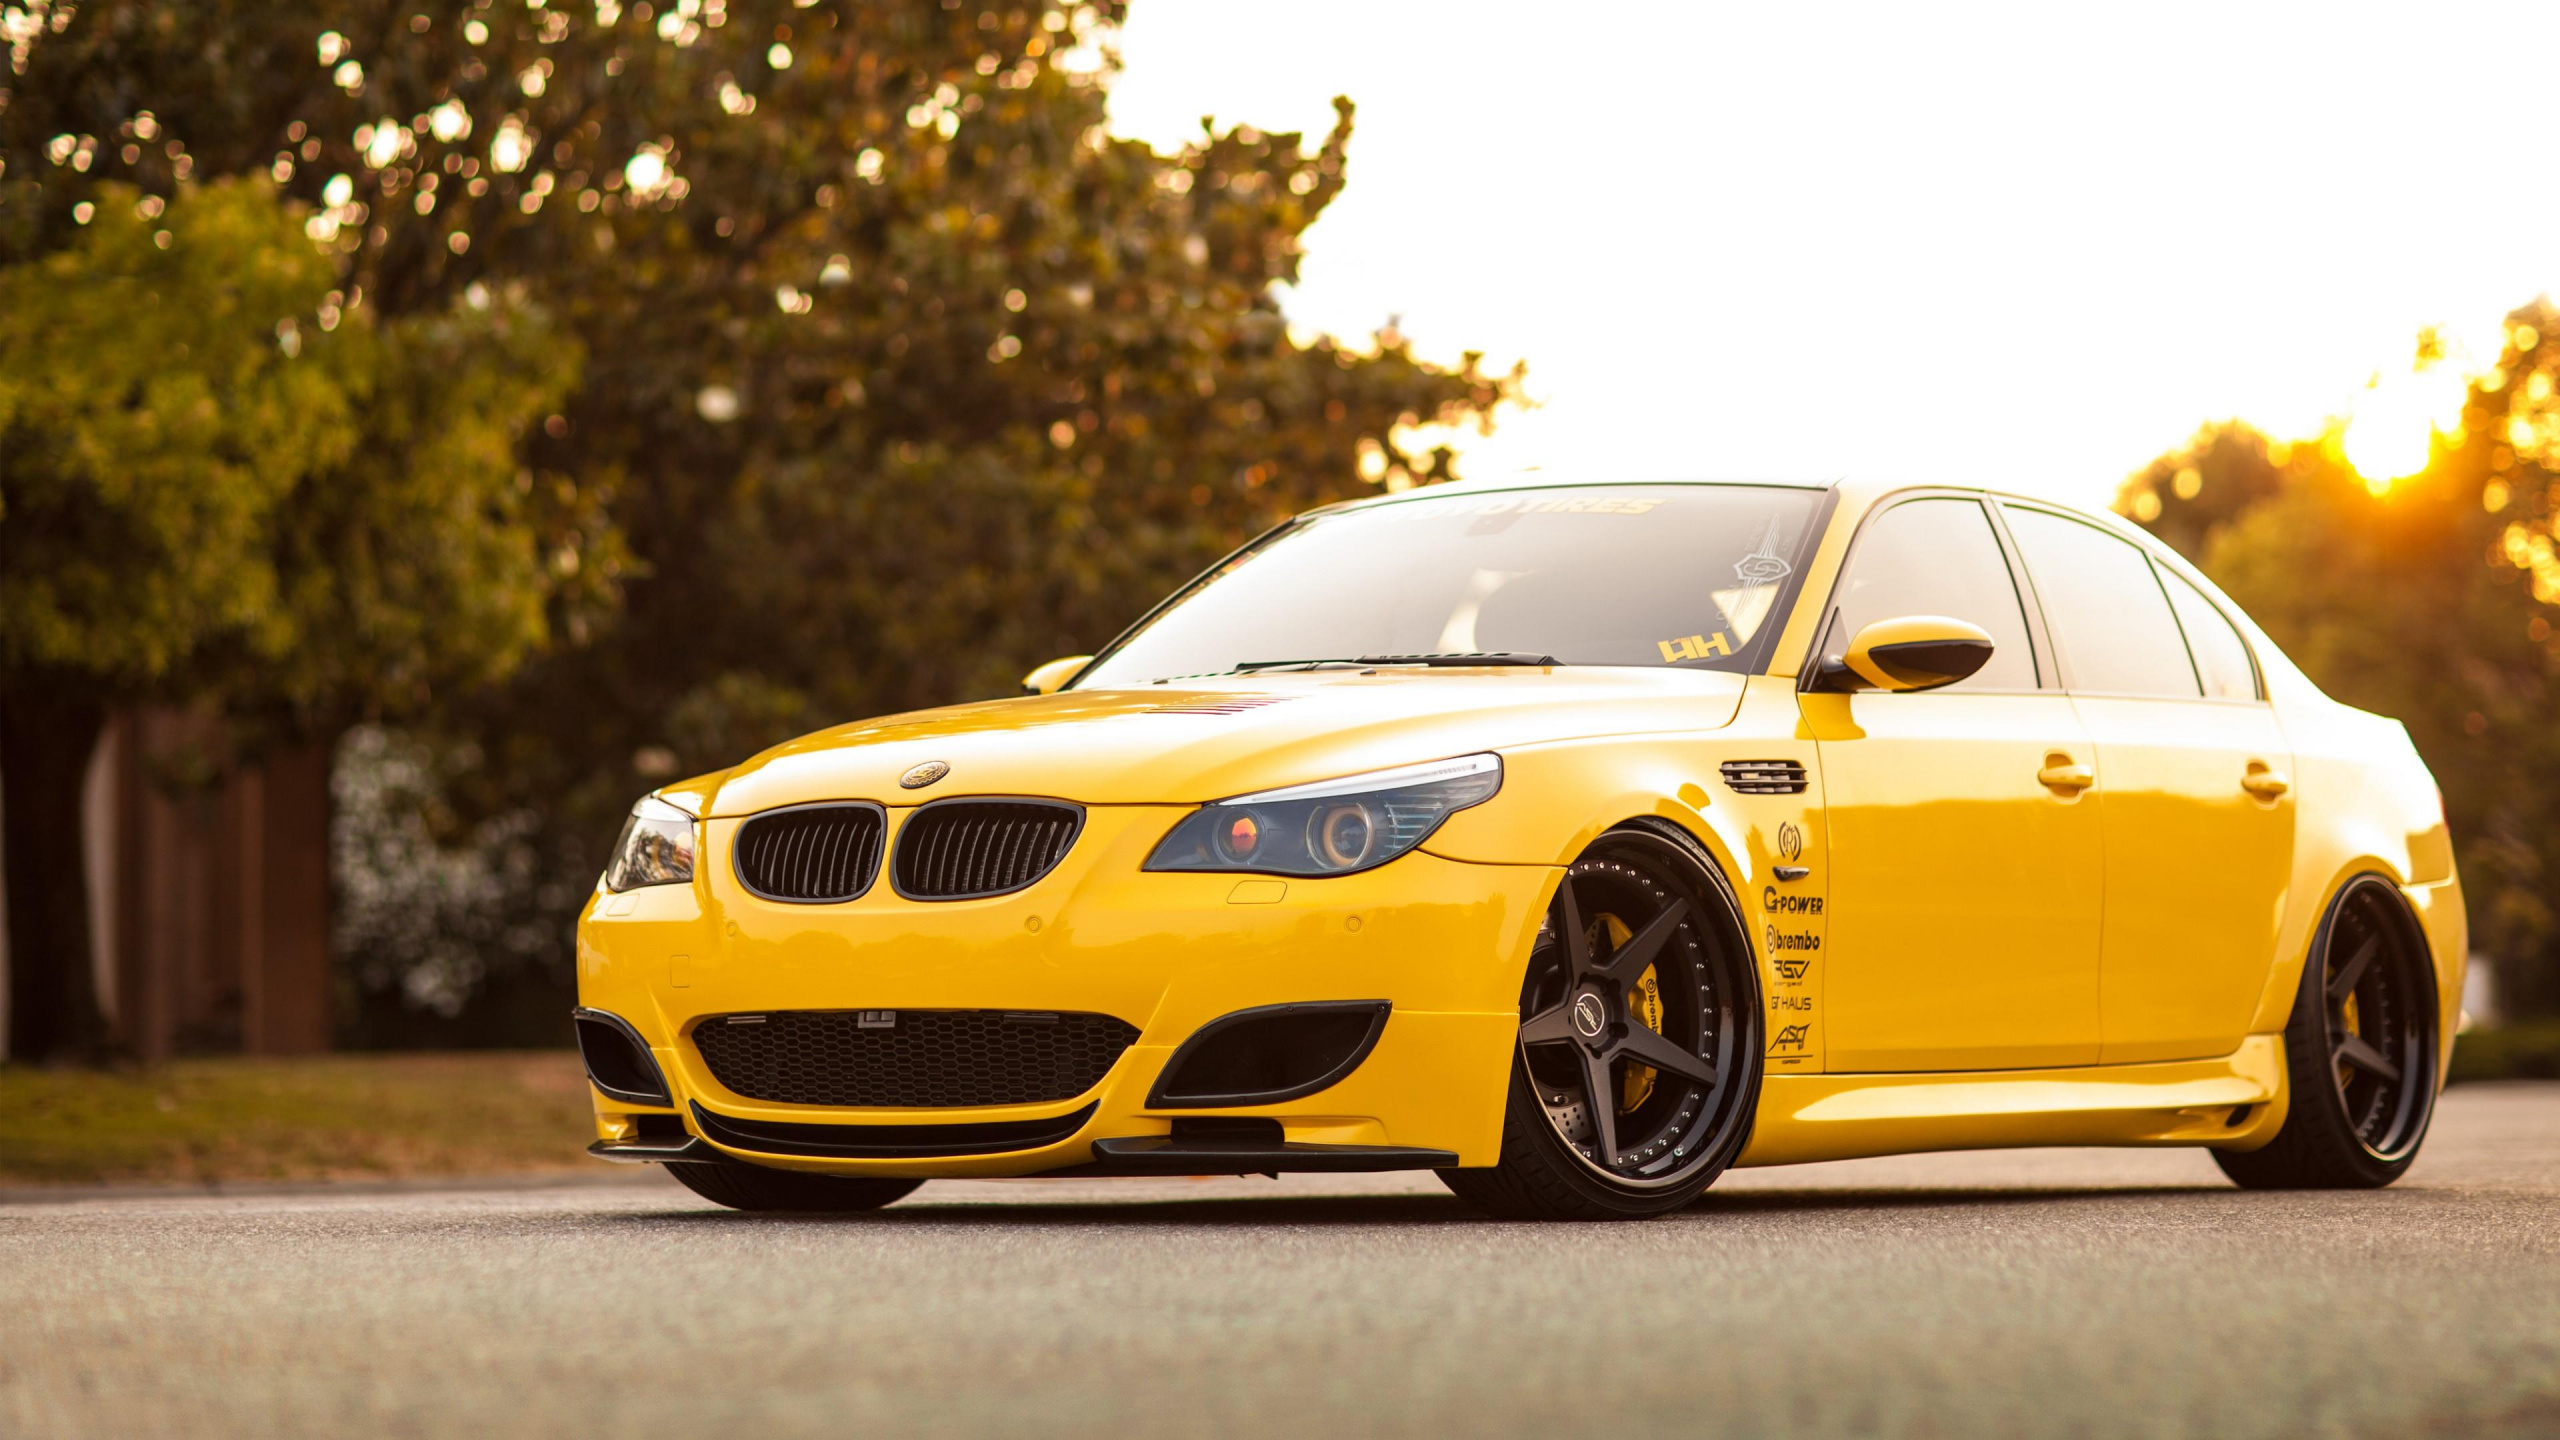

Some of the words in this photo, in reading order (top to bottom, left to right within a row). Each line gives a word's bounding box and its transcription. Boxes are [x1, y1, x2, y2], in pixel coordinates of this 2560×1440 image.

[1516, 498, 1667, 514] TIRES
[1764, 886, 1824, 914] G-POWER
[1776, 929, 1820, 950] brembo
[1648, 994, 1659, 1032] bremb
[1782, 996, 1811, 1011] HAUS
